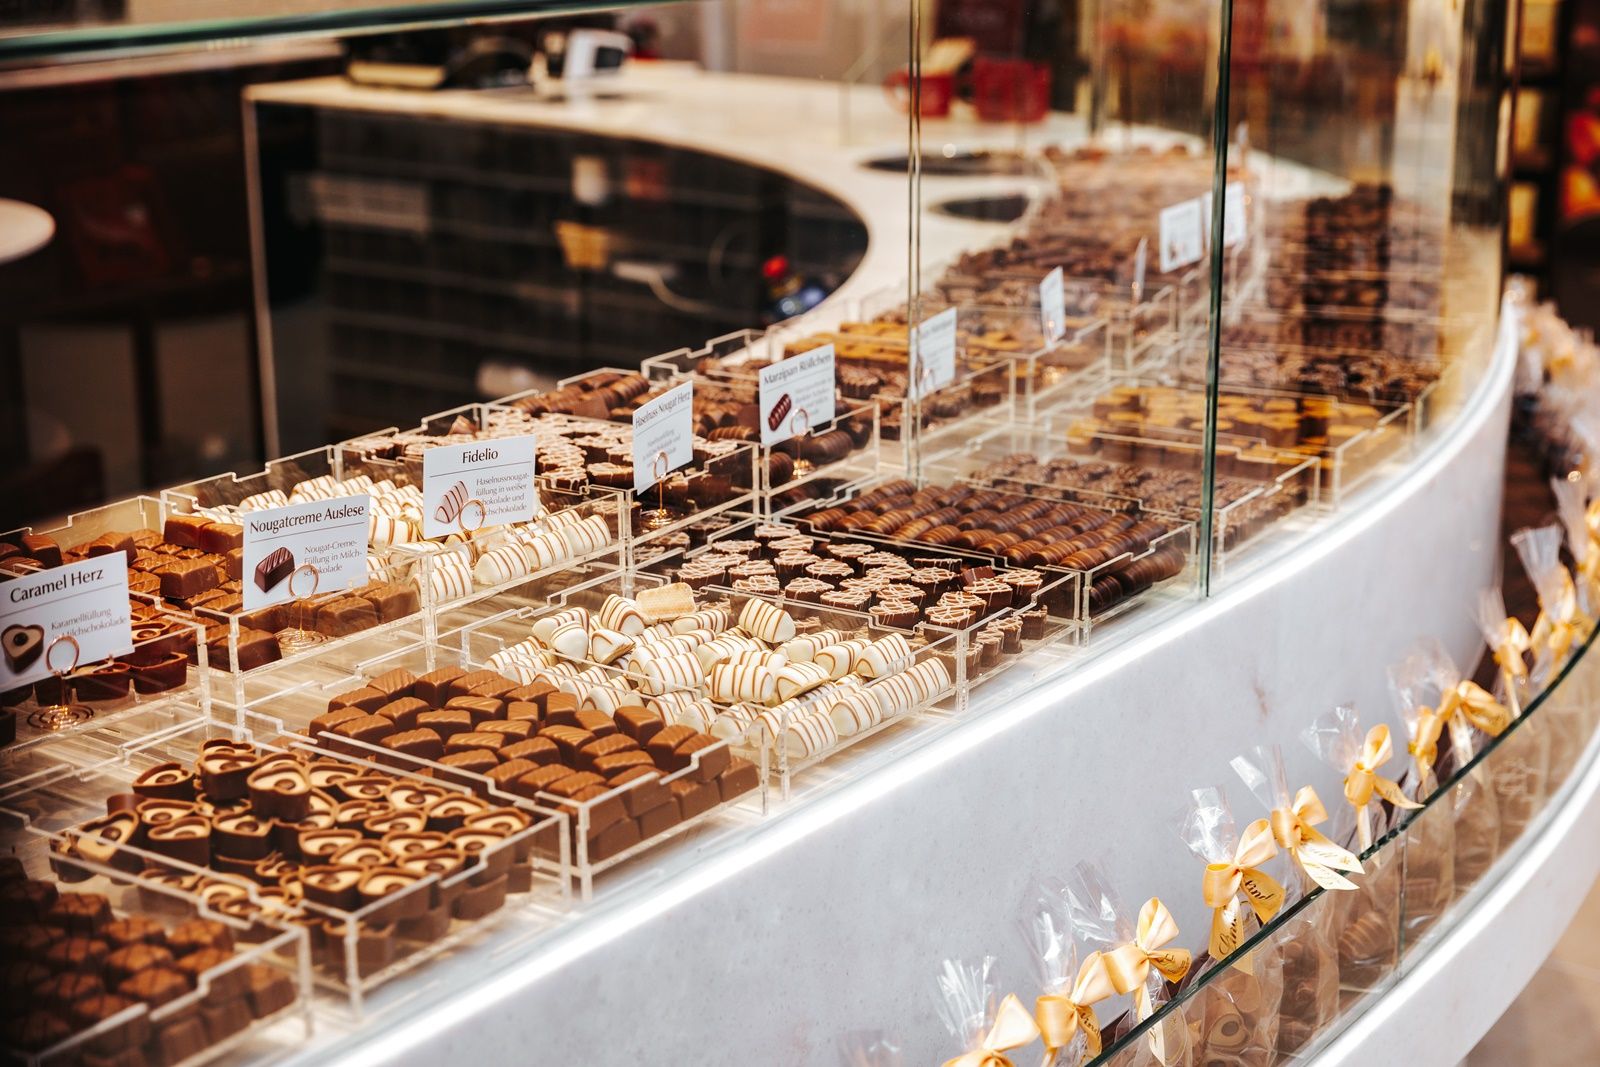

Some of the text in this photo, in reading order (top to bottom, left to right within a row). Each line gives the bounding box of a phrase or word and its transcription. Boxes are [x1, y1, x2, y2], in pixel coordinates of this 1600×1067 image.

[763, 366, 798, 384] Marzipan
[659, 397, 677, 412] Nougat
[678, 391, 690, 404] Herz
[462, 448, 499, 464] Fidelio
[512, 493, 525, 501] und
[249, 504, 365, 535] Nougatcreme Auslese
[304, 540, 357, 554] Nougat-Creme-
[340, 548, 362, 559] Milch-
[10, 569, 104, 603] Caramel Herz
[51, 608, 112, 631] Karamellfüllung
